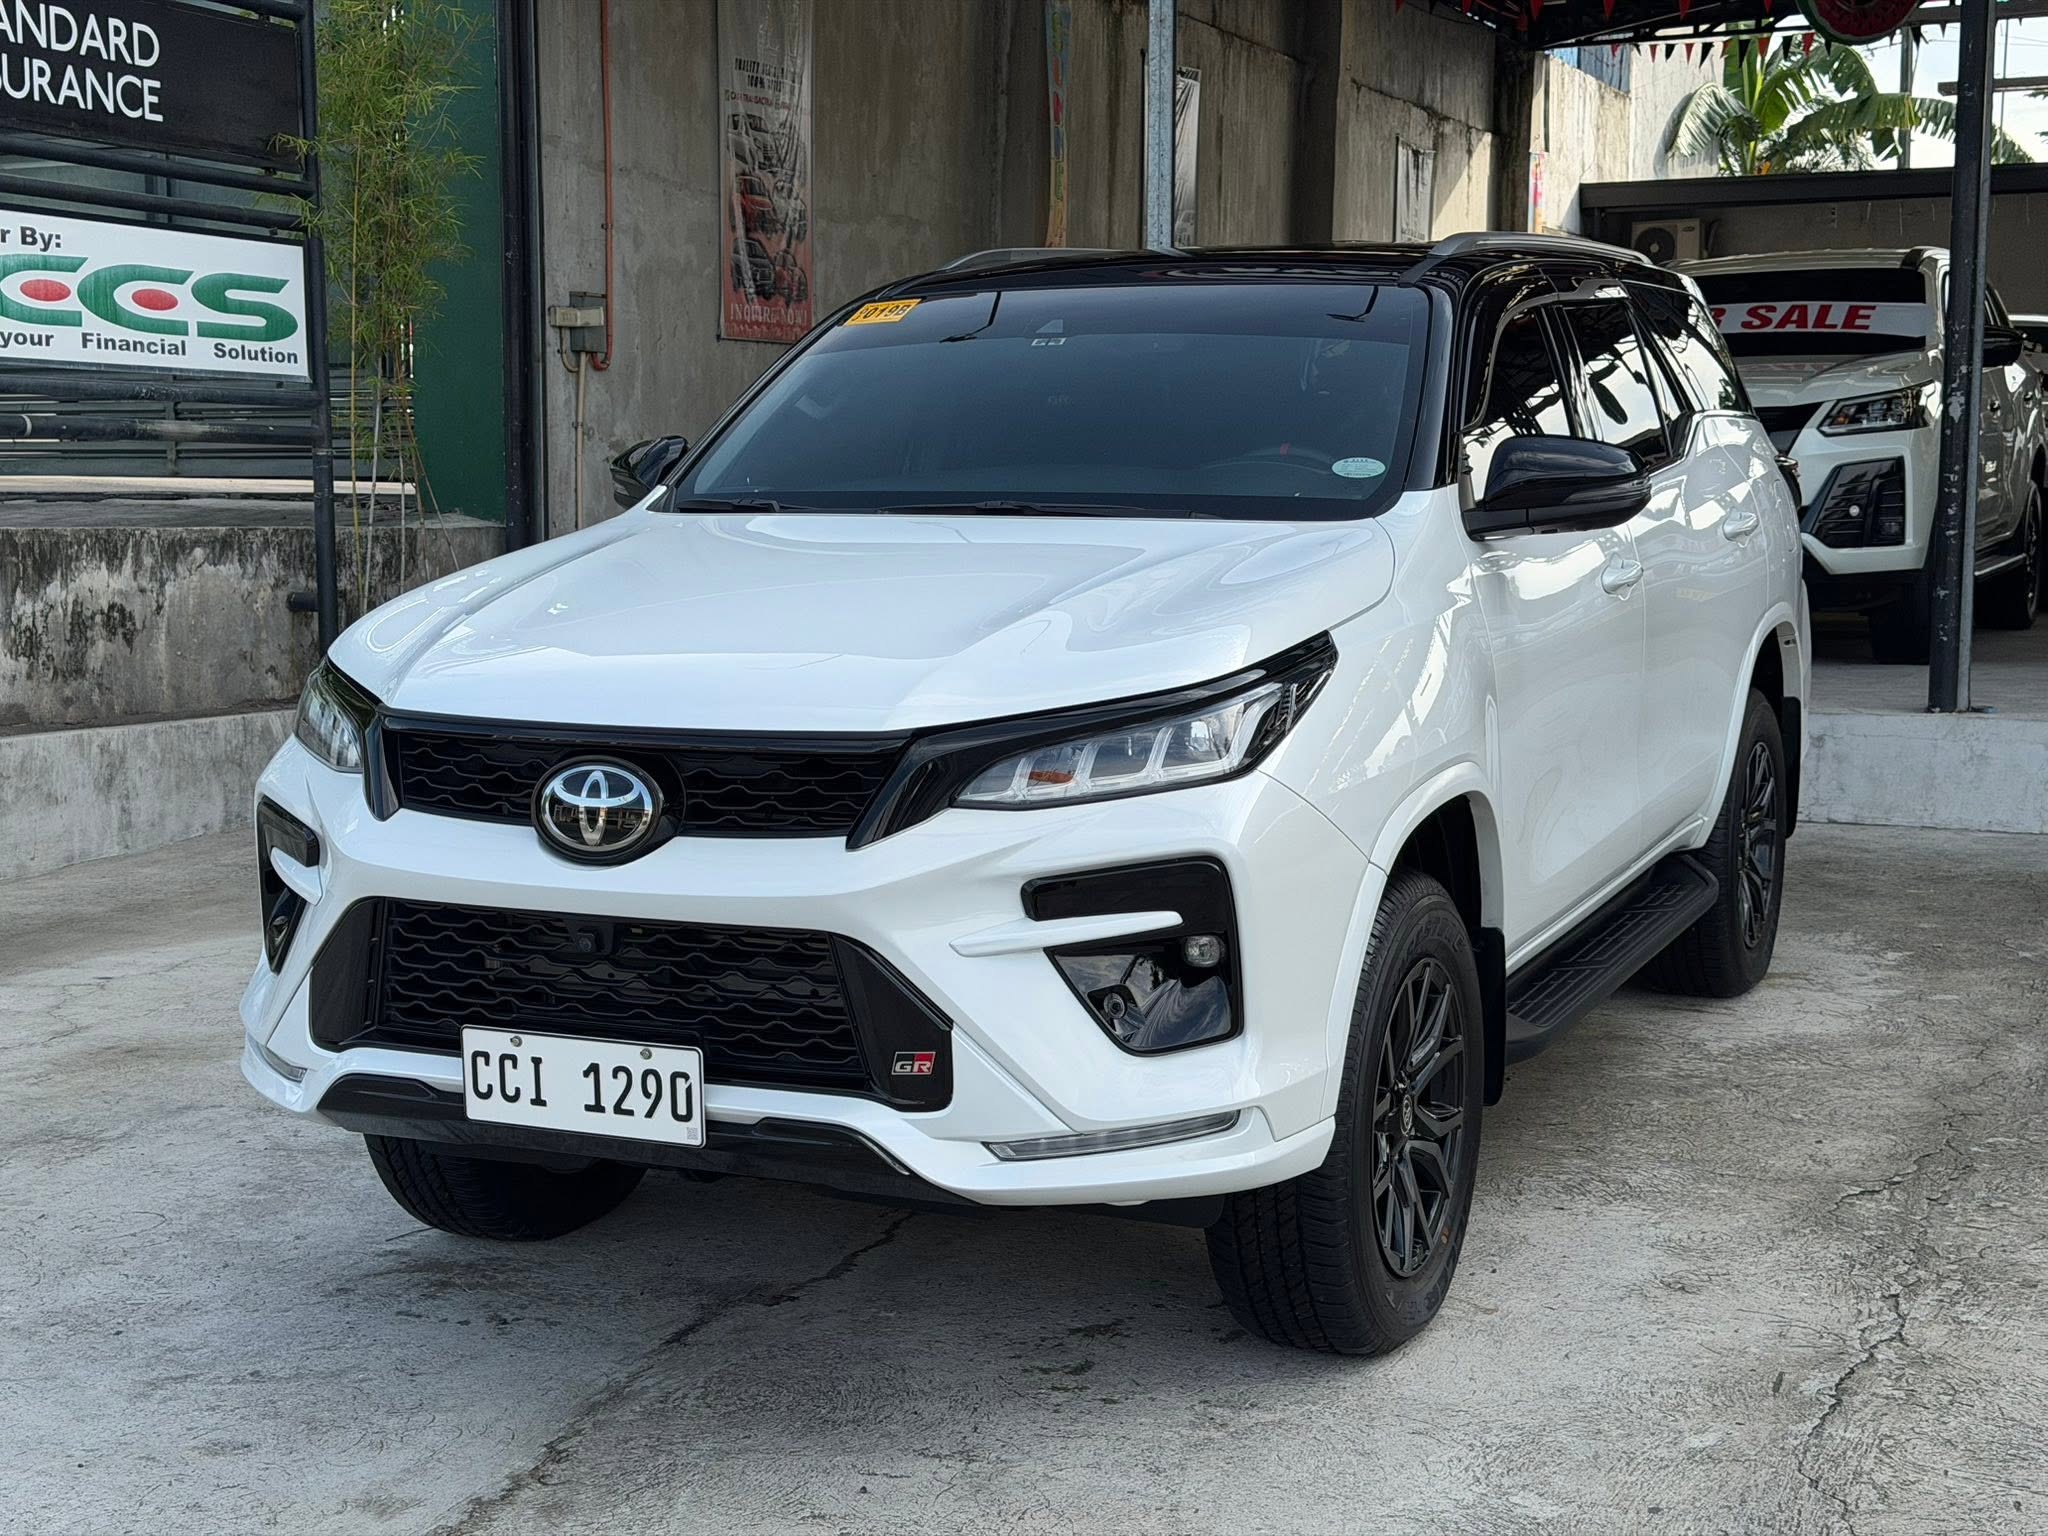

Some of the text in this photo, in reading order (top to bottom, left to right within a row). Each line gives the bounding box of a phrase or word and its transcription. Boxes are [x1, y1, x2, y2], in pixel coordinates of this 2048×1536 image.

[0, 53, 164, 122] URANCE
[20, 226, 62, 252] By:
[1740, 304, 1877, 330] SALE
[0, 331, 299, 364] your Financial Solution
[894, 1060, 932, 1073] GR
[471, 1050, 694, 1123] CCI 1290
